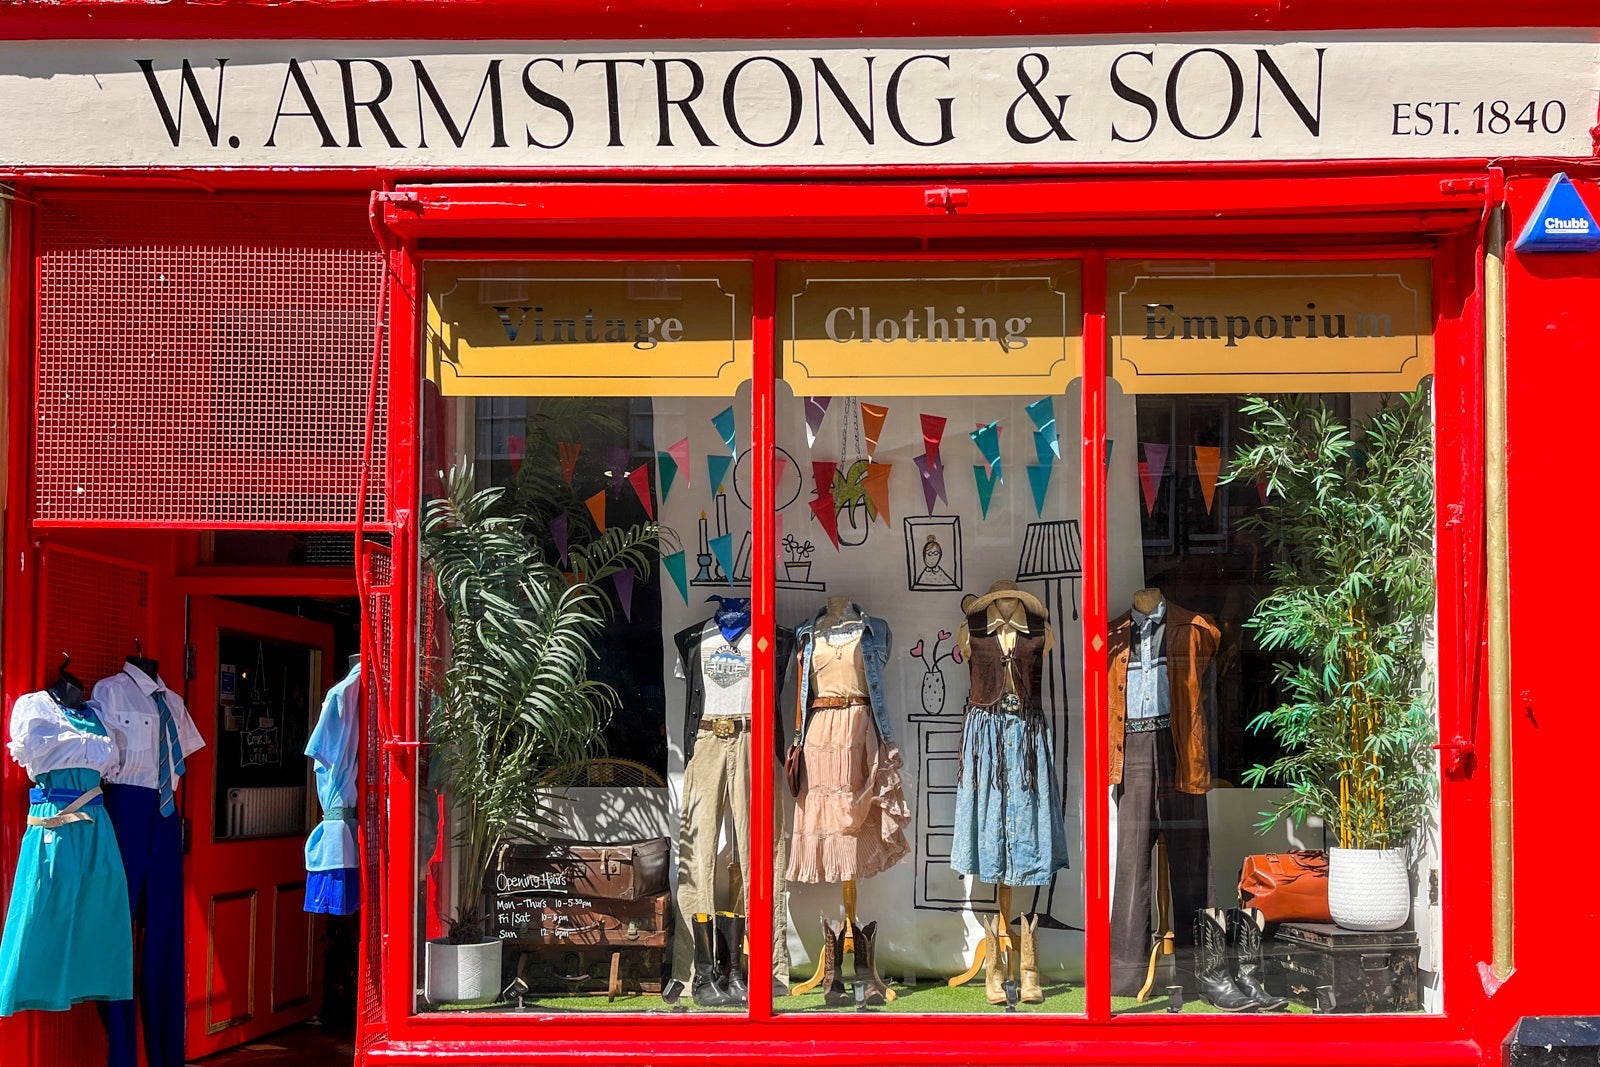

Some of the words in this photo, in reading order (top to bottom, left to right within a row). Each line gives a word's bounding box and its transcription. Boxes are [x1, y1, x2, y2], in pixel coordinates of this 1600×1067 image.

[133, 58, 240, 148] W.
[262, 54, 956, 149] ARMSTRONG
[1005, 52, 1077, 144] &
[1110, 47, 1326, 142] SON
[1391, 101, 1460, 136] EST.
[1473, 99, 1567, 134] 1840
[1544, 217, 1589, 229] Chubb
[491, 305, 685, 351] Vintage
[824, 306, 1033, 350] Clothing
[1141, 302, 1396, 347] Emporium
[496, 873, 540, 891] Opening
[541, 872, 567, 889] Hours
[499, 929, 517, 939] Sun
